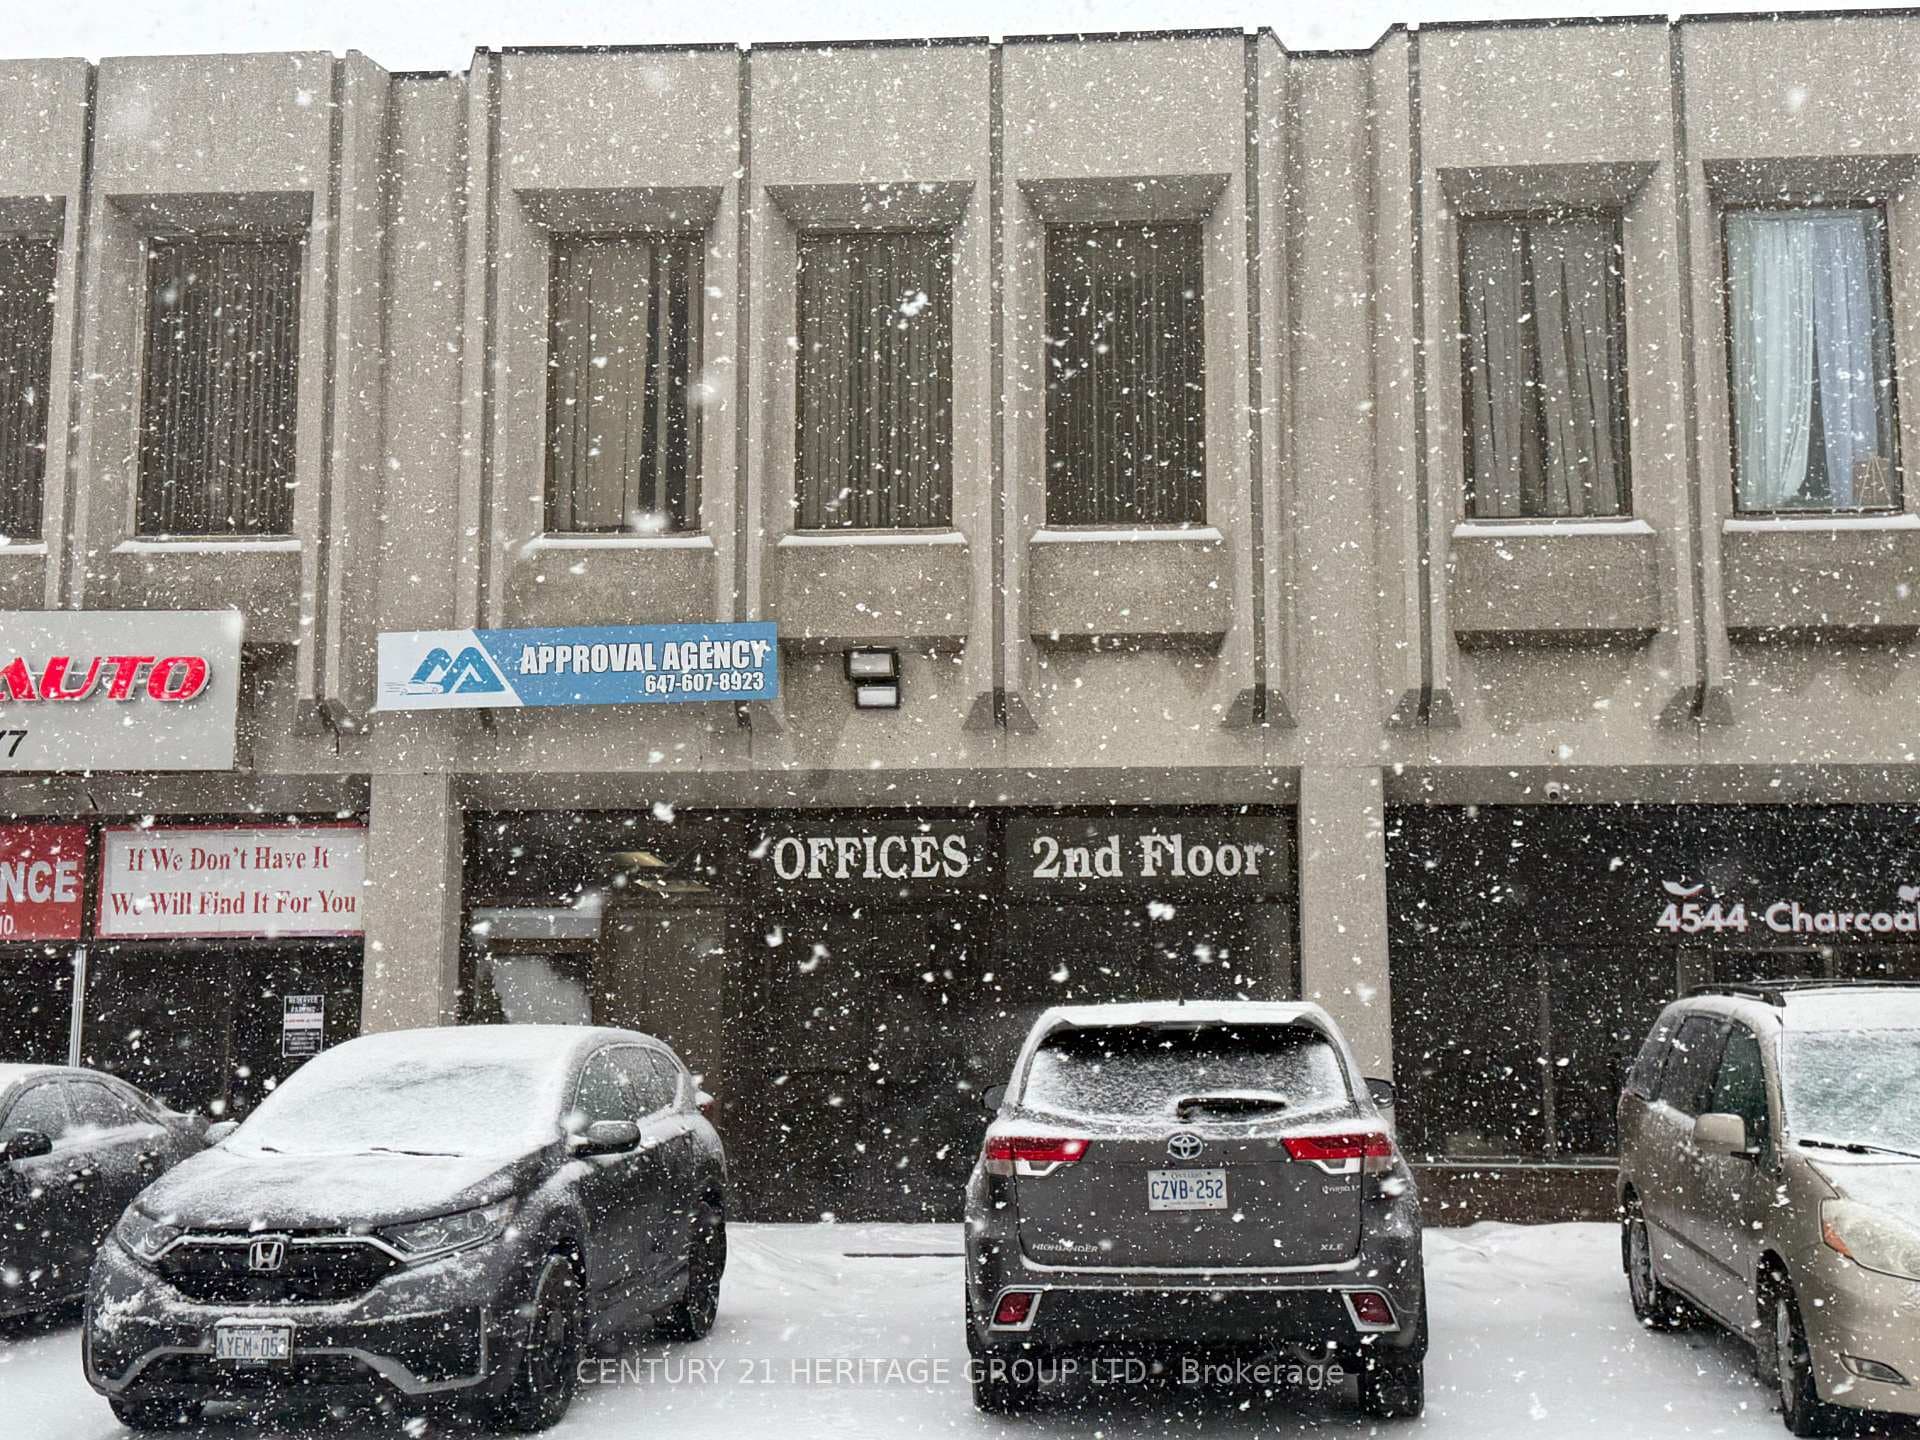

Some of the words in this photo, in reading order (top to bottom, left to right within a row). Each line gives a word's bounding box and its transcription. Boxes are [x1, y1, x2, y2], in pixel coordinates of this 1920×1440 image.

[520, 641, 656, 675] APPROVAL
[662, 639, 768, 672] AGENCY
[0, 656, 211, 702] AUTO
[645, 671, 764, 693] 647-607-8923
[129, 848, 147, 871] If
[151, 848, 183, 871] We
[191, 846, 248, 870] Don't
[254, 847, 306, 869] Have
[312, 846, 329, 868] It
[774, 834, 969, 879] OFFICES
[1033, 835, 1123, 878] 2nd
[1140, 833, 1265, 877] Floor
[0, 860, 78, 903] NCE
[150, 891, 192, 914] Will
[199, 891, 245, 914] Find
[253, 891, 269, 913] It
[276, 890, 312, 913] For
[318, 889, 356, 912] You
[1656, 903, 1748, 933] 4544
[1152, 1180, 1188, 1199] CZVB
[1196, 1180, 1223, 1199] 252
